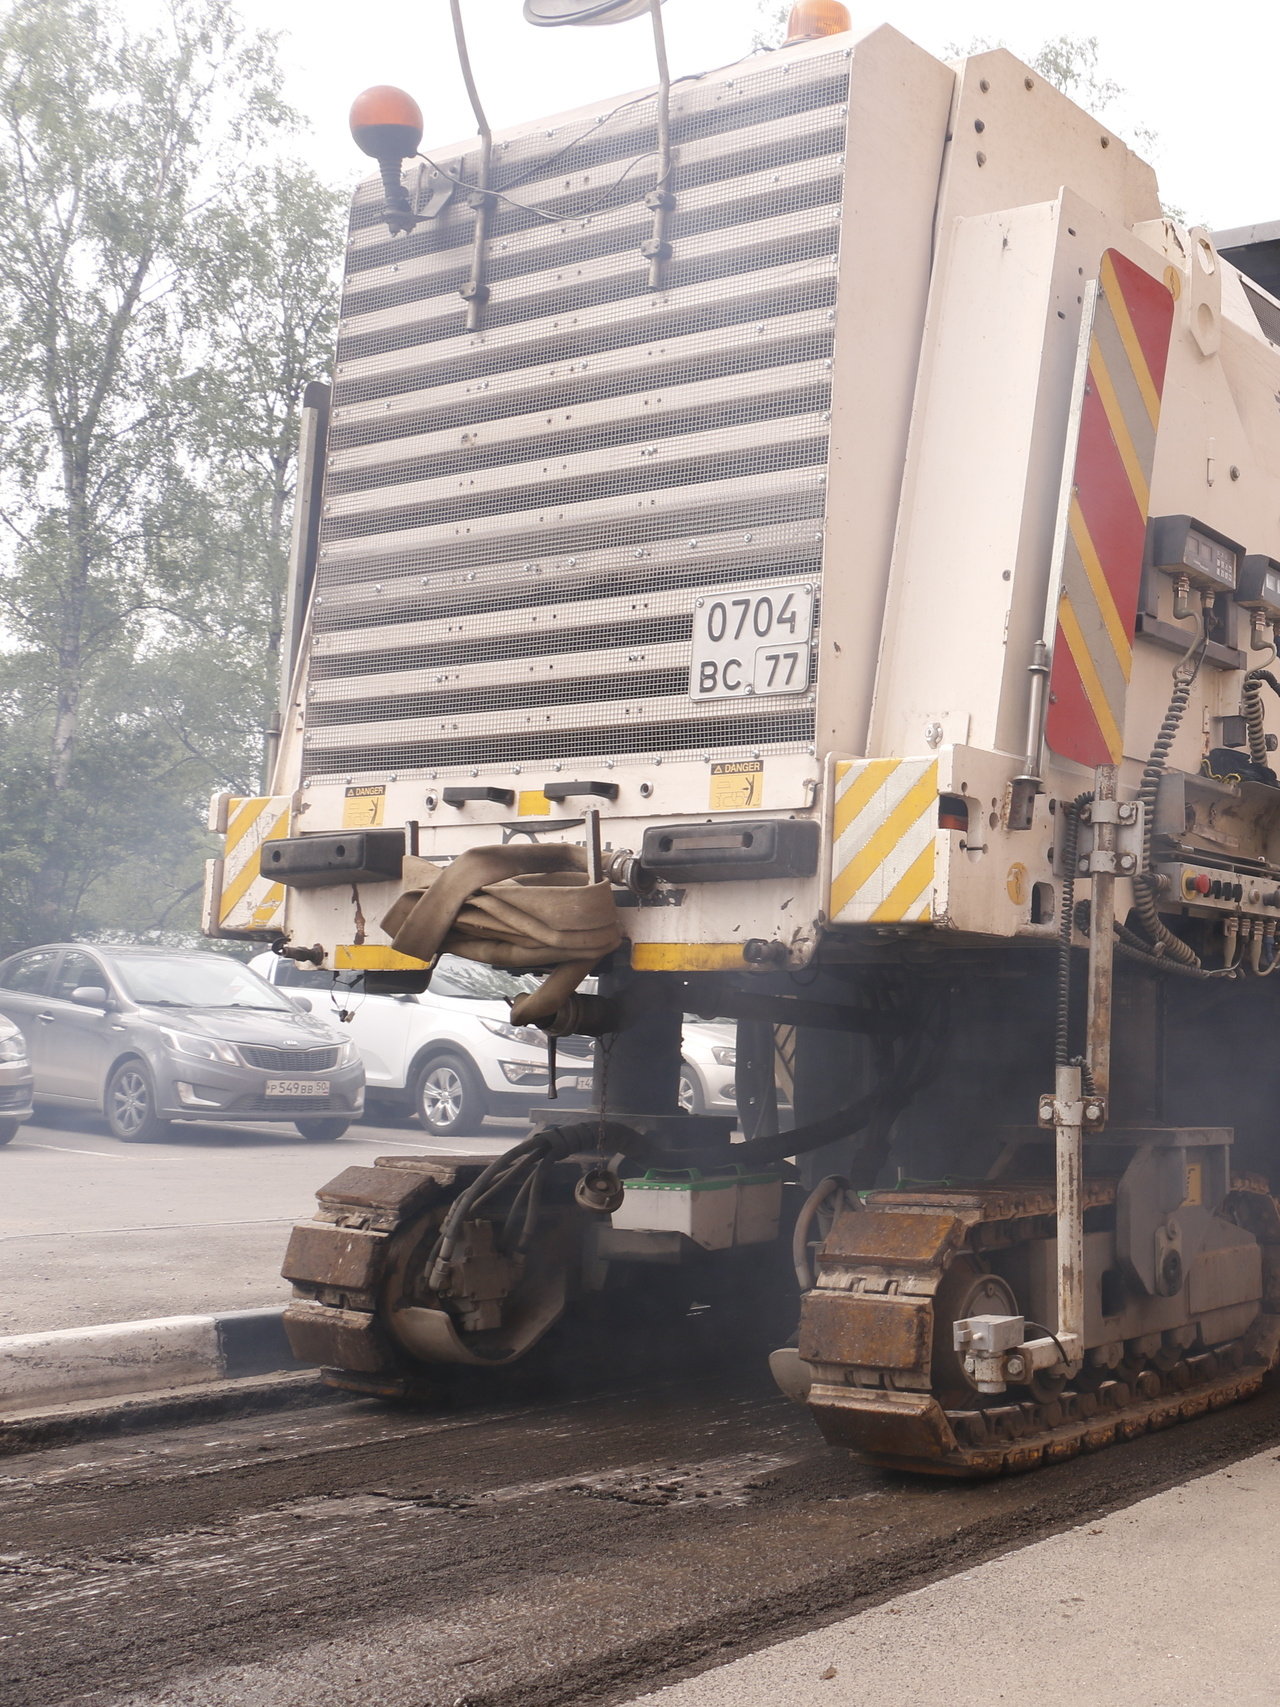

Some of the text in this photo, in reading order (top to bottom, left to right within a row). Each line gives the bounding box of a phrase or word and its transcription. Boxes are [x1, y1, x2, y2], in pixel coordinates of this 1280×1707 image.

[708, 592, 796, 642] 0704
[699, 652, 799, 693] ВС 77
[725, 762, 761, 773] DANGER
[355, 786, 384, 796] DANGER
